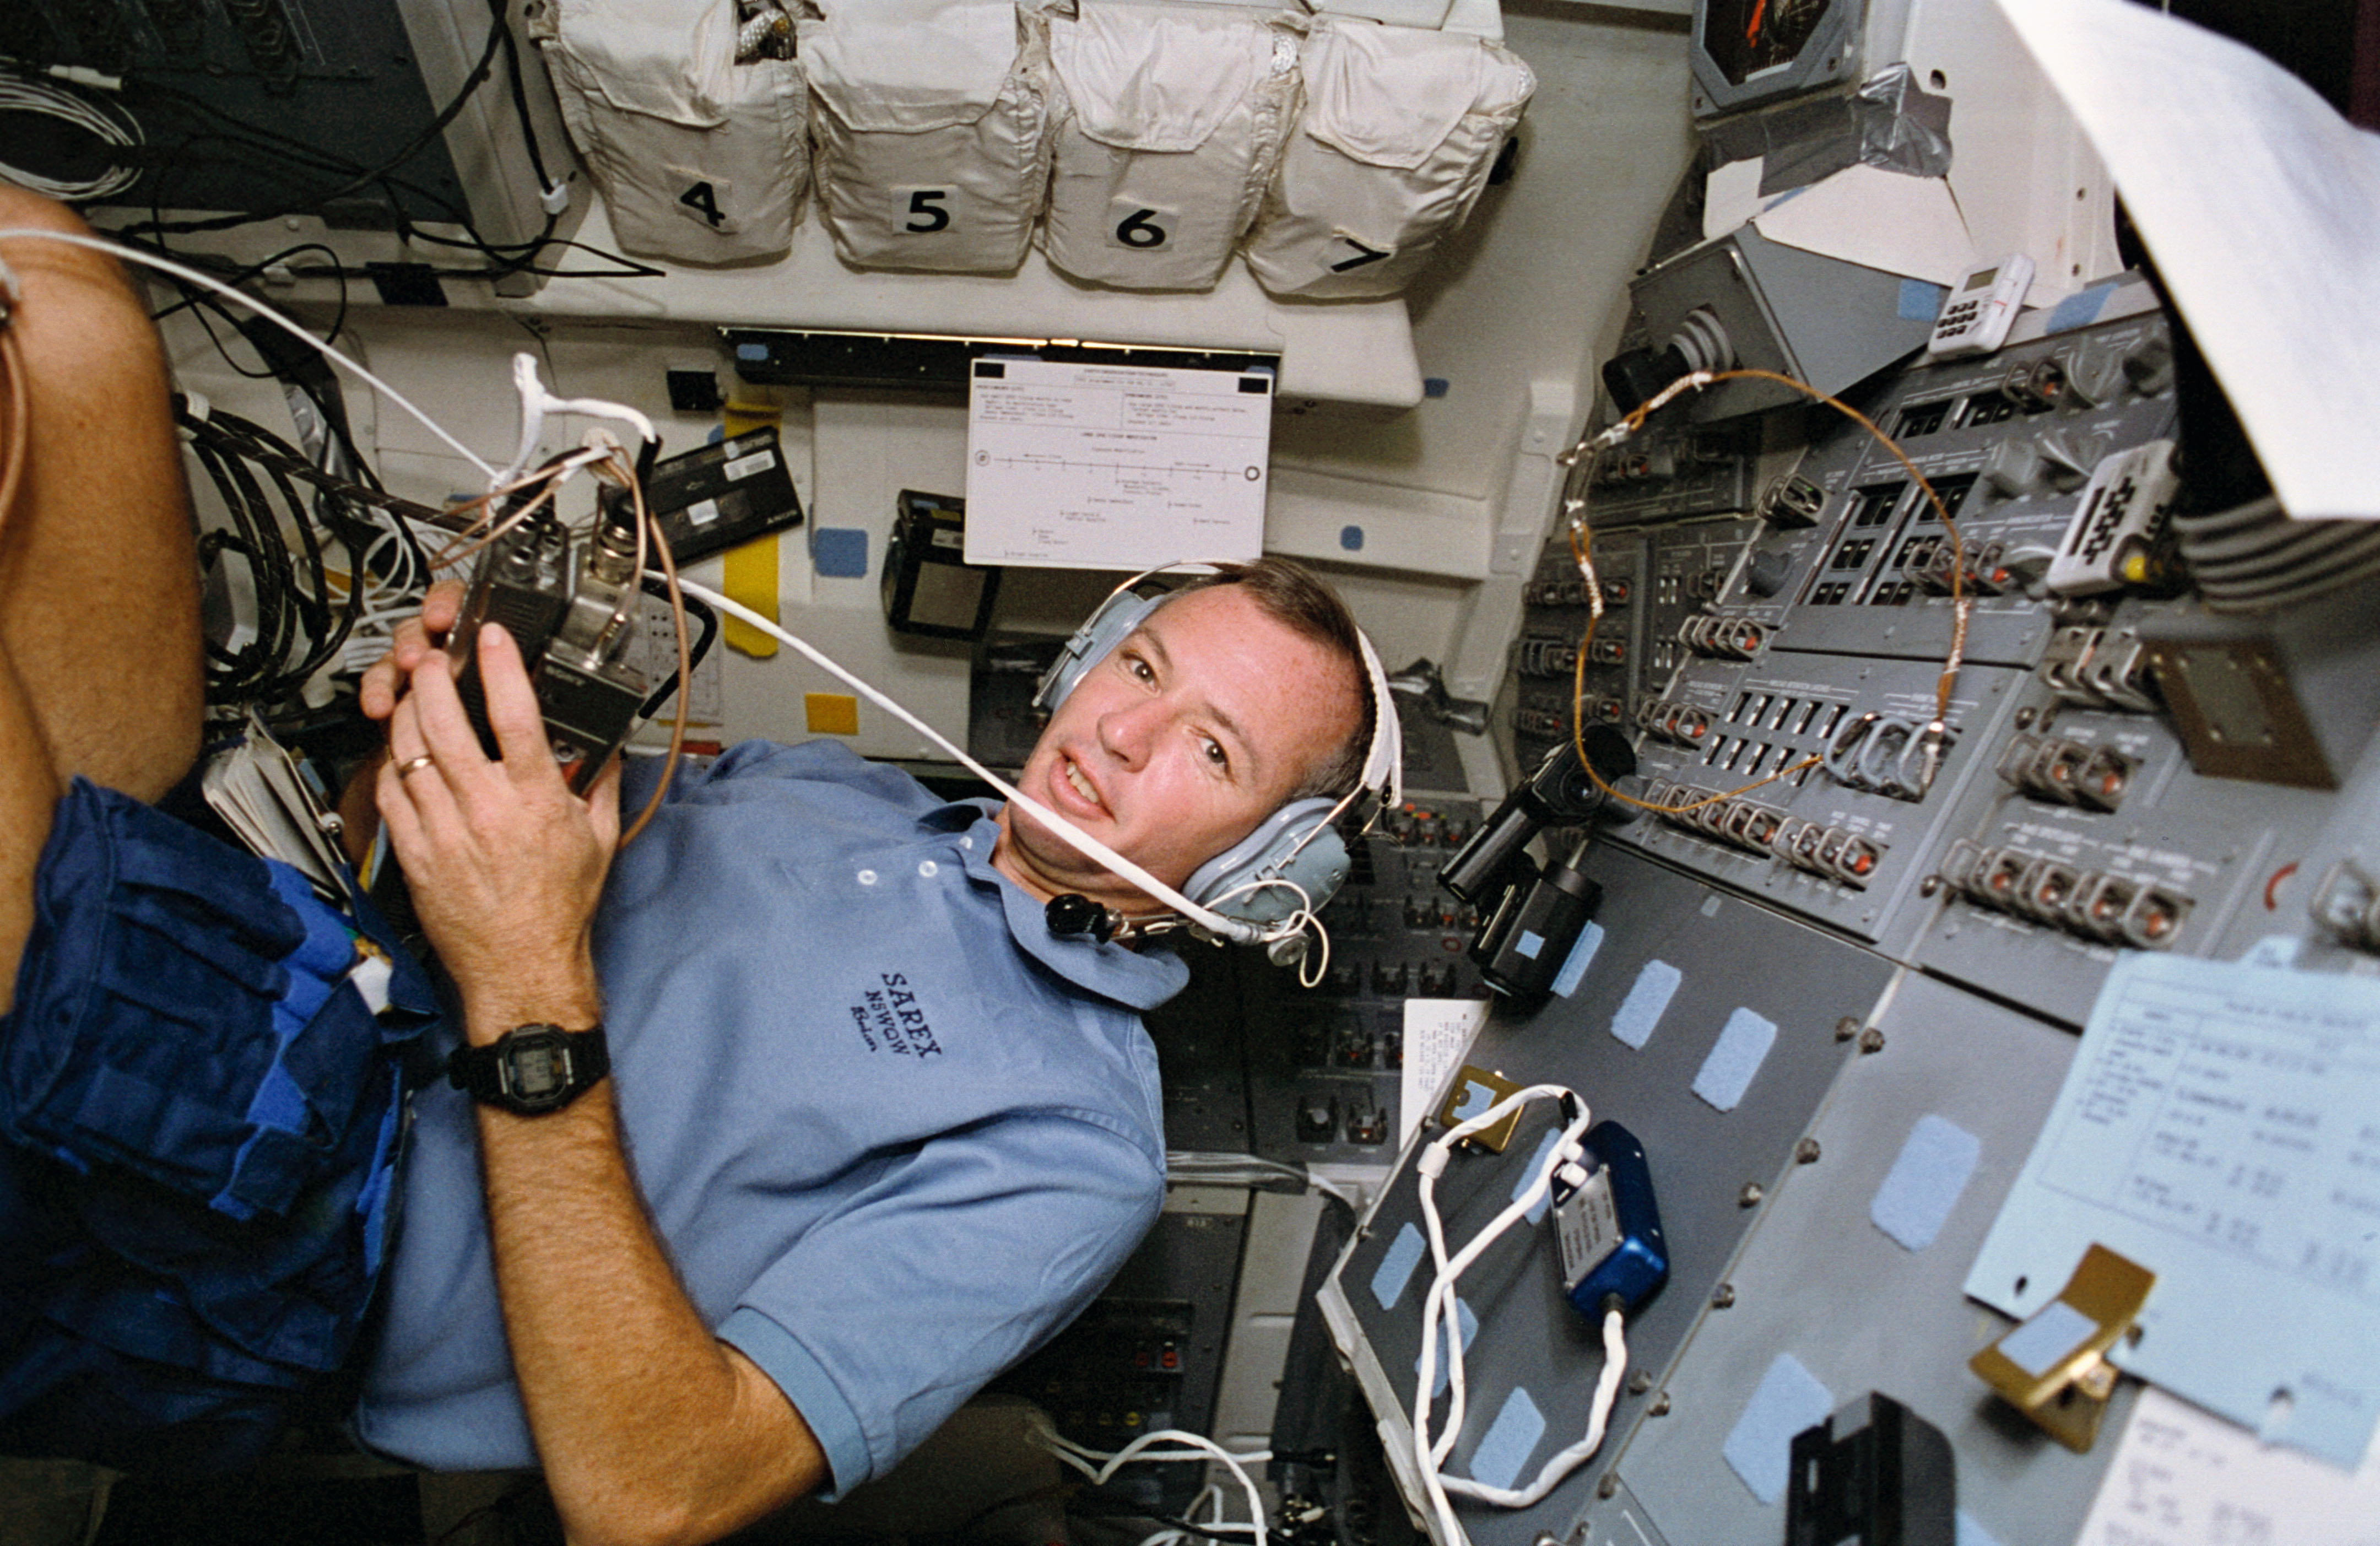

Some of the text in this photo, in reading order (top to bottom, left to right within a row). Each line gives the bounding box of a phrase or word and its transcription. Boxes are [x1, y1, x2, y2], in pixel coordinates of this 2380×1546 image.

[680, 181, 726, 228] 4
[906, 191, 950, 234] 5
[1117, 209, 1166, 248] 6
[1330, 238, 1391, 273] 7
[881, 973, 942, 1058] SAREX
